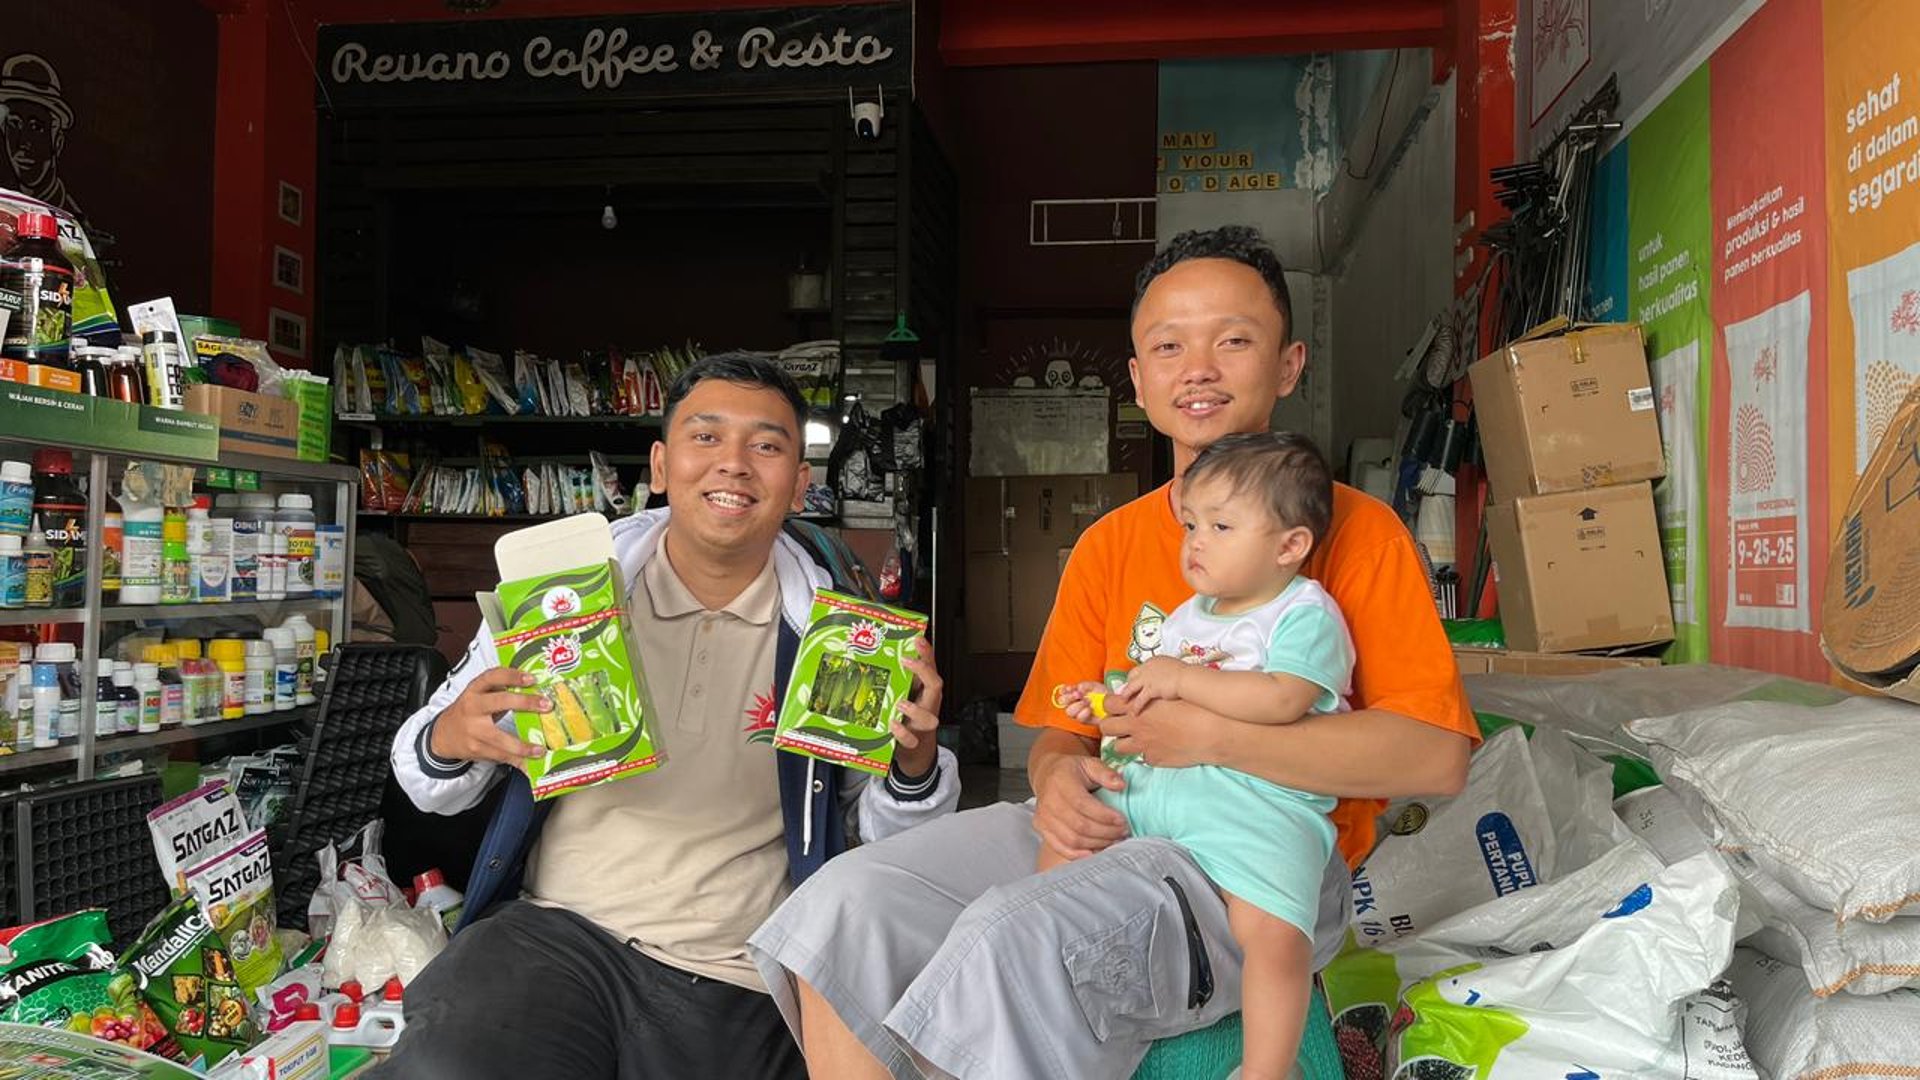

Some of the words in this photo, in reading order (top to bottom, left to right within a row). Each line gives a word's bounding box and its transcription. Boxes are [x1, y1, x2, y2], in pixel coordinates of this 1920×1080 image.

[331, 42, 511, 84] Revano
[524, 27, 679, 89] Coffee
[689, 29, 723, 71] &
[738, 27, 894, 69] Resto
[1846, 71, 1901, 134] sehat
[1163, 134, 1212, 147] MAY
[1183, 155, 1249, 169] YOUR
[1847, 142, 1862, 173] di
[1865, 115, 1918, 162] dalam
[1638, 231, 1663, 262] untuk
[1725, 212, 1770, 260] produksi
[1771, 211, 1781, 229] &
[1782, 195, 1804, 224] hasil
[1639, 263, 1659, 292] hasil
[1659, 249, 1690, 284] panen
[1725, 258, 1750, 285] panen
[1750, 229, 1801, 267] berkualitas
[1639, 279, 1699, 325] berkualitas
[1738, 536, 1795, 565] 9-25-25
[857, 635, 875, 646] ACS
[172, 807, 240, 864] SATGAZ
[208, 851, 272, 905] SATGAZ
